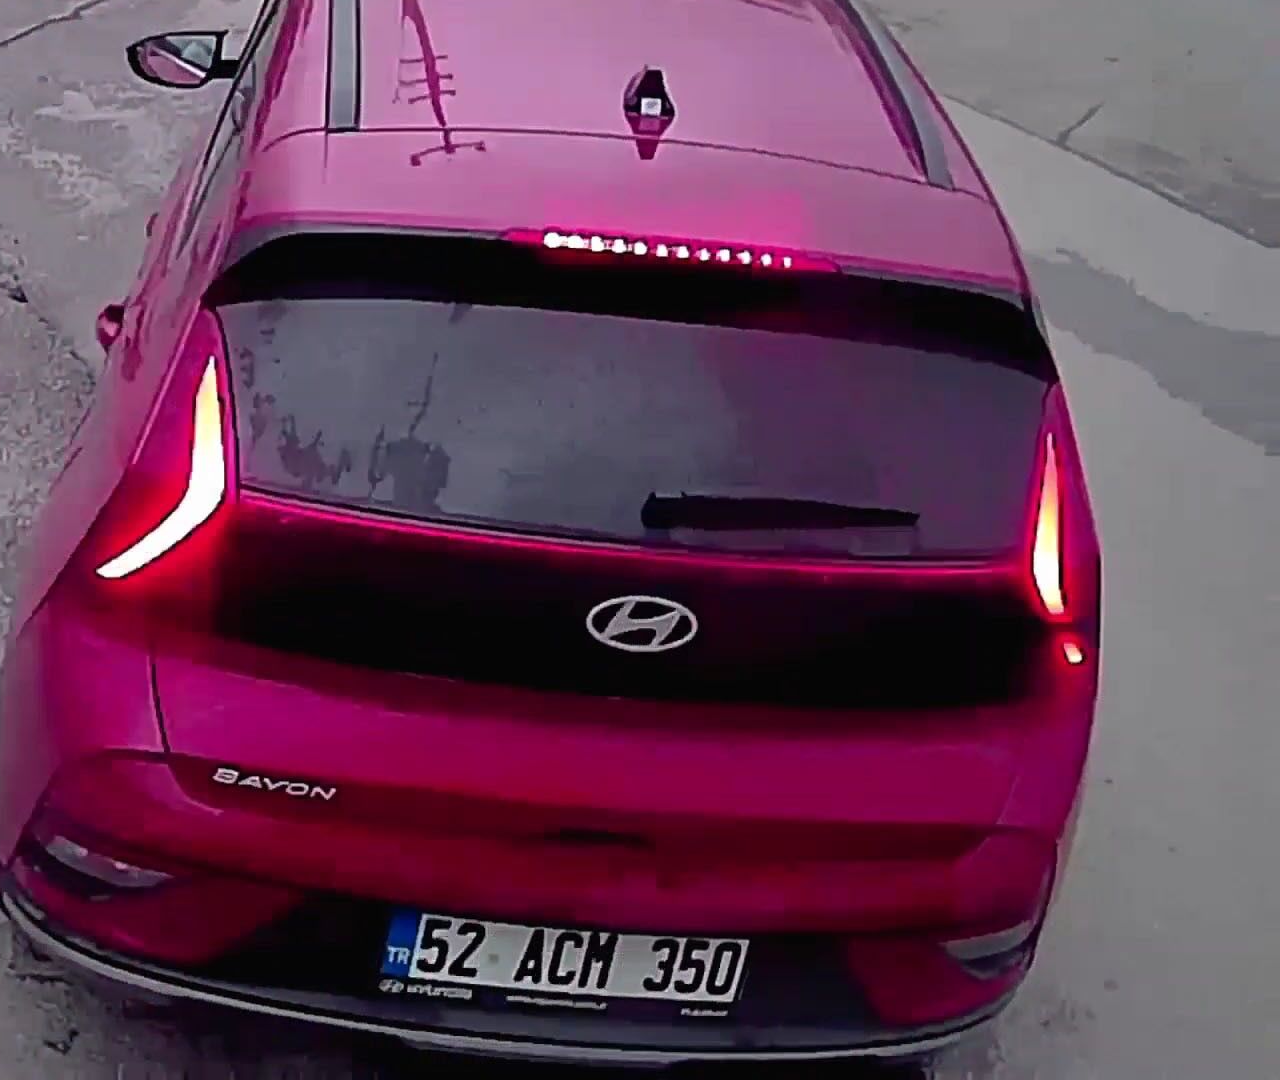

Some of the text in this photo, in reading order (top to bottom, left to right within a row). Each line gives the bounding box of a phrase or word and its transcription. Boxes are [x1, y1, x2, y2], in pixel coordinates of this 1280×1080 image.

[212, 767, 337, 800] BAYON
[387, 920, 743, 996] TR 52 ACM 350
